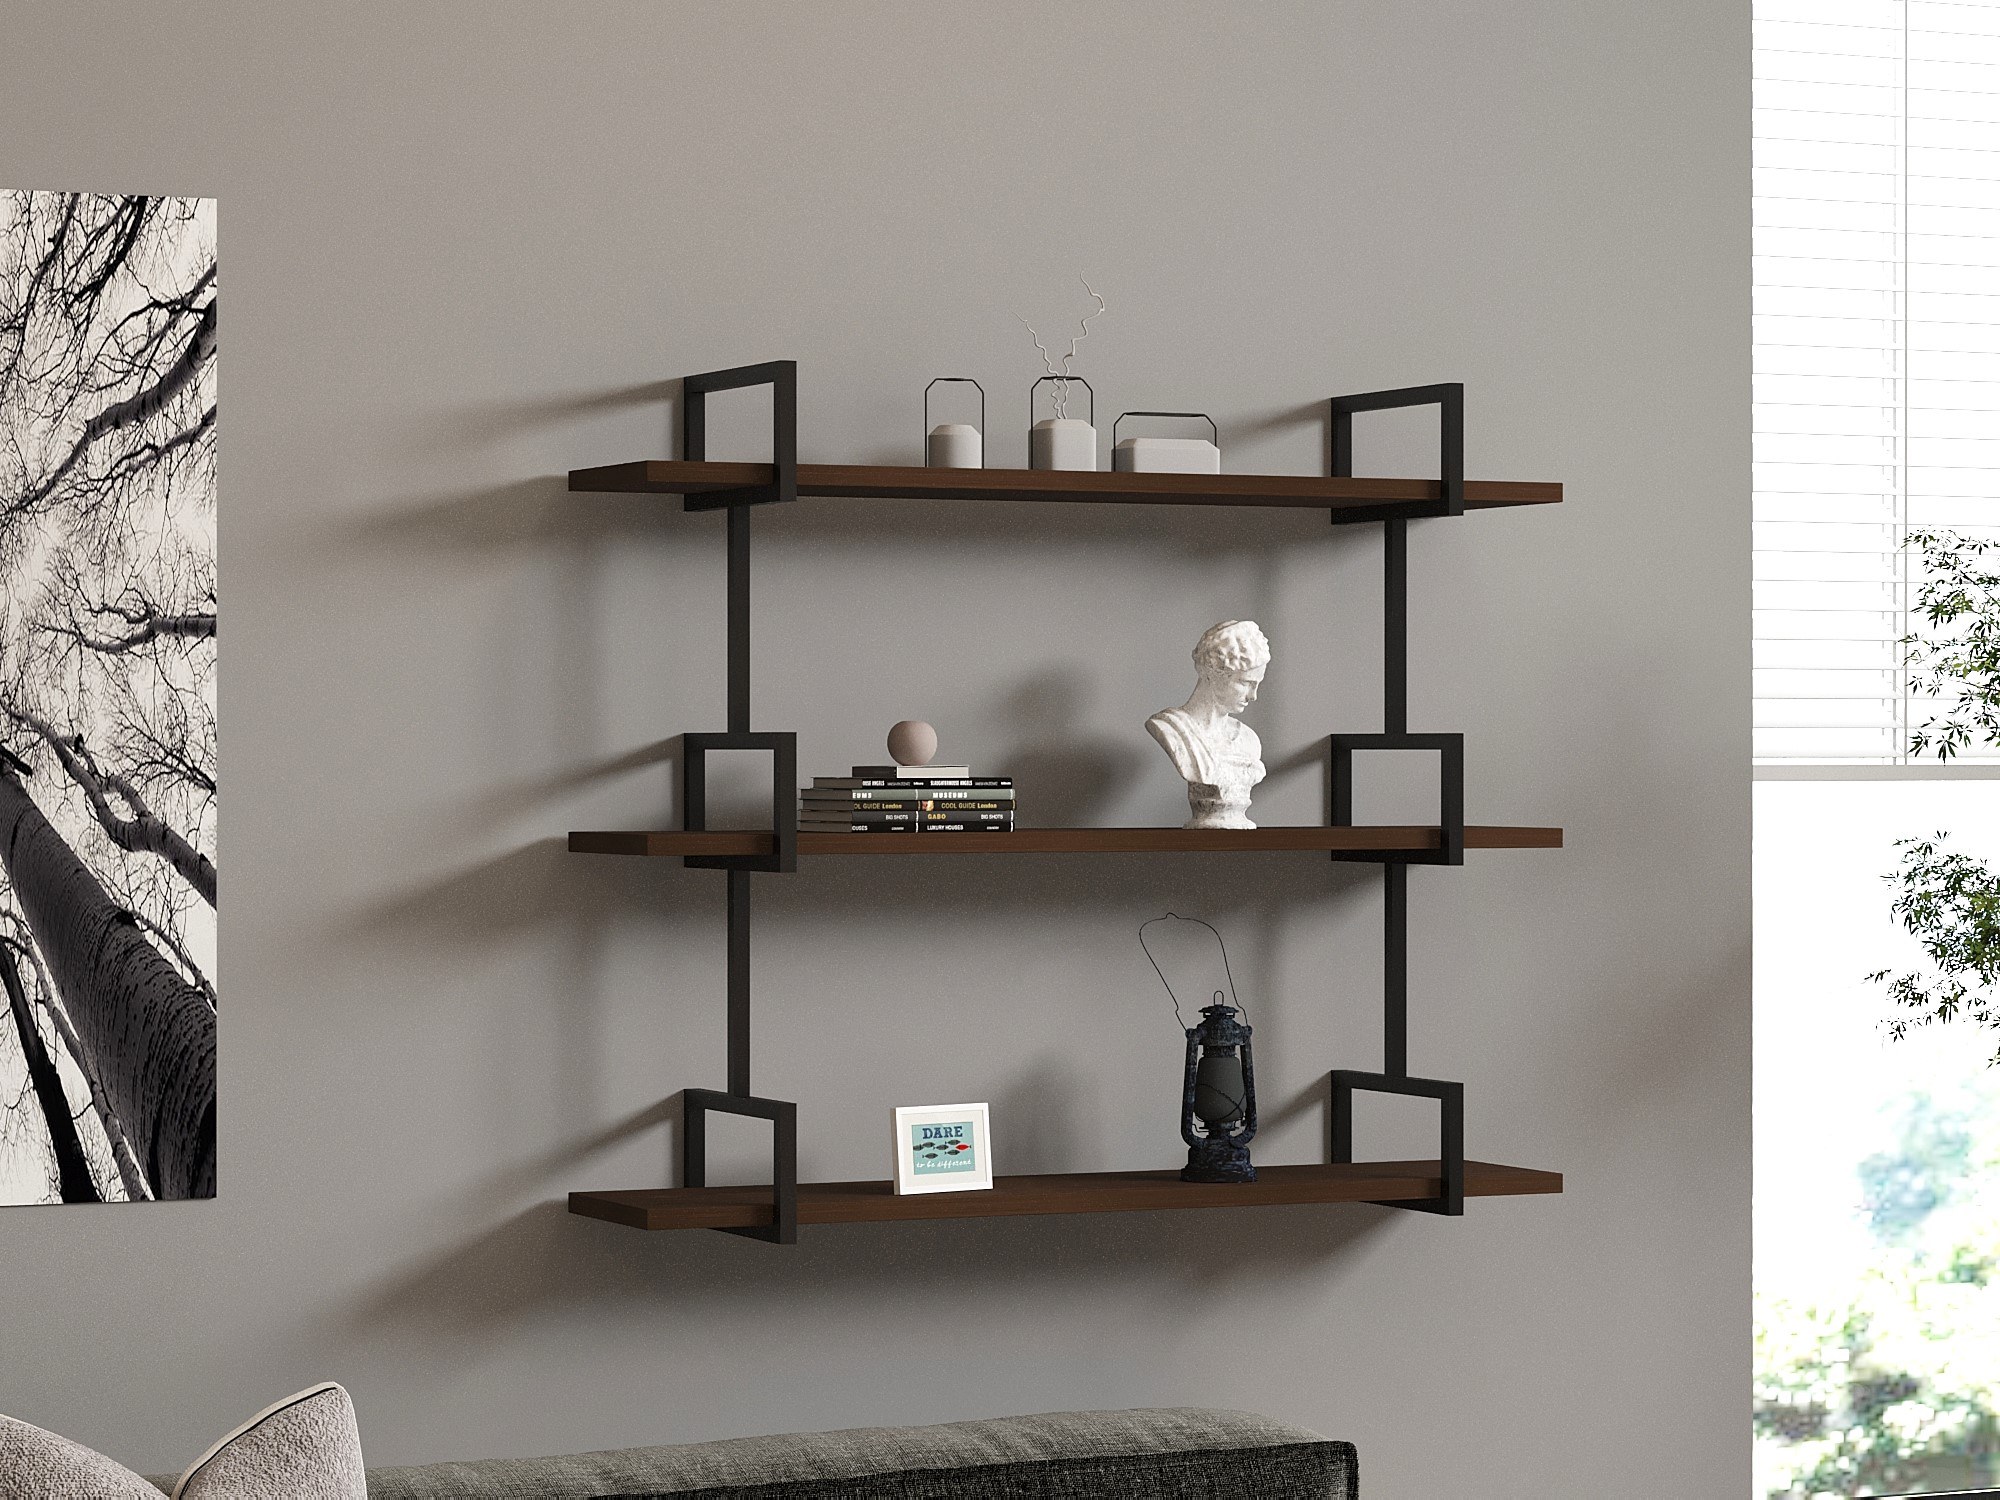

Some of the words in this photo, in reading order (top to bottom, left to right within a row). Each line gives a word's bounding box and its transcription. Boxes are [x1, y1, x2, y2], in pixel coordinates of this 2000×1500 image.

[922, 1126, 963, 1139] DARE
[926, 1160, 935, 1168] be
[937, 1159, 971, 1169] different
